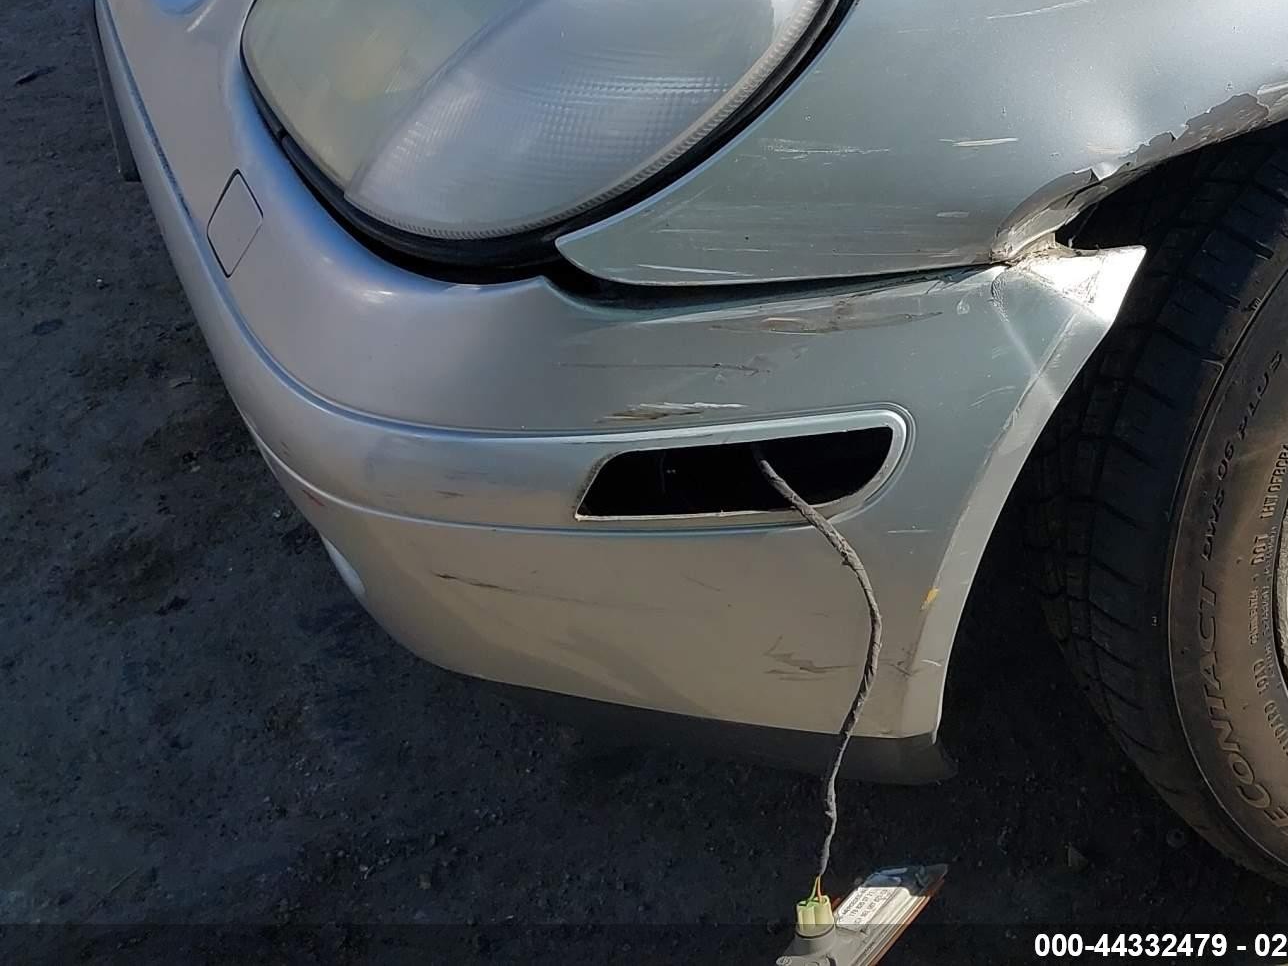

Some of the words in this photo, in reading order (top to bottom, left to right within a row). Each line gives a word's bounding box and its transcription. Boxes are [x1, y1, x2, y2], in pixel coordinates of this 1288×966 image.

[1237, 349, 1284, 442] PLUS
[1249, 534, 1270, 567] DOT
[1252, 658, 1270, 697] LOAD
